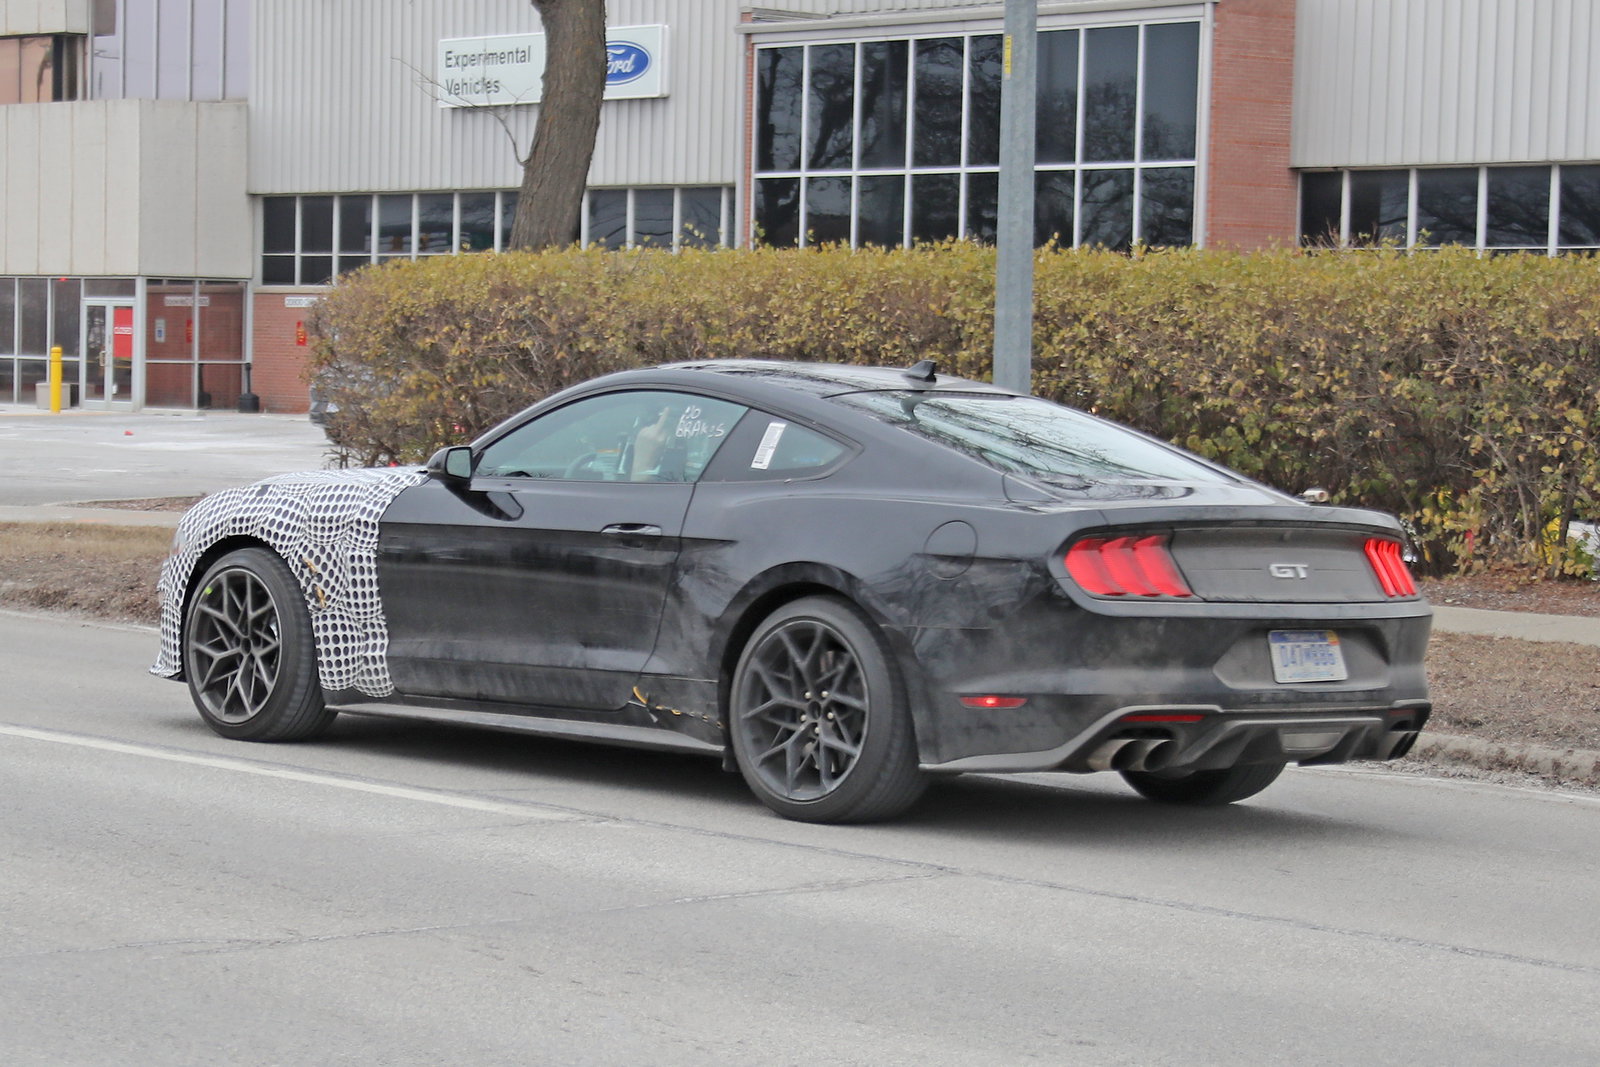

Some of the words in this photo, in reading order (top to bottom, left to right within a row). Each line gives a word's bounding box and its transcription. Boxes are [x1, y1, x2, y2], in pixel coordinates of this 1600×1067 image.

[444, 45, 531, 72] Experimental
[445, 77, 500, 96] Vehicles
[1269, 563, 1309, 580] GT
